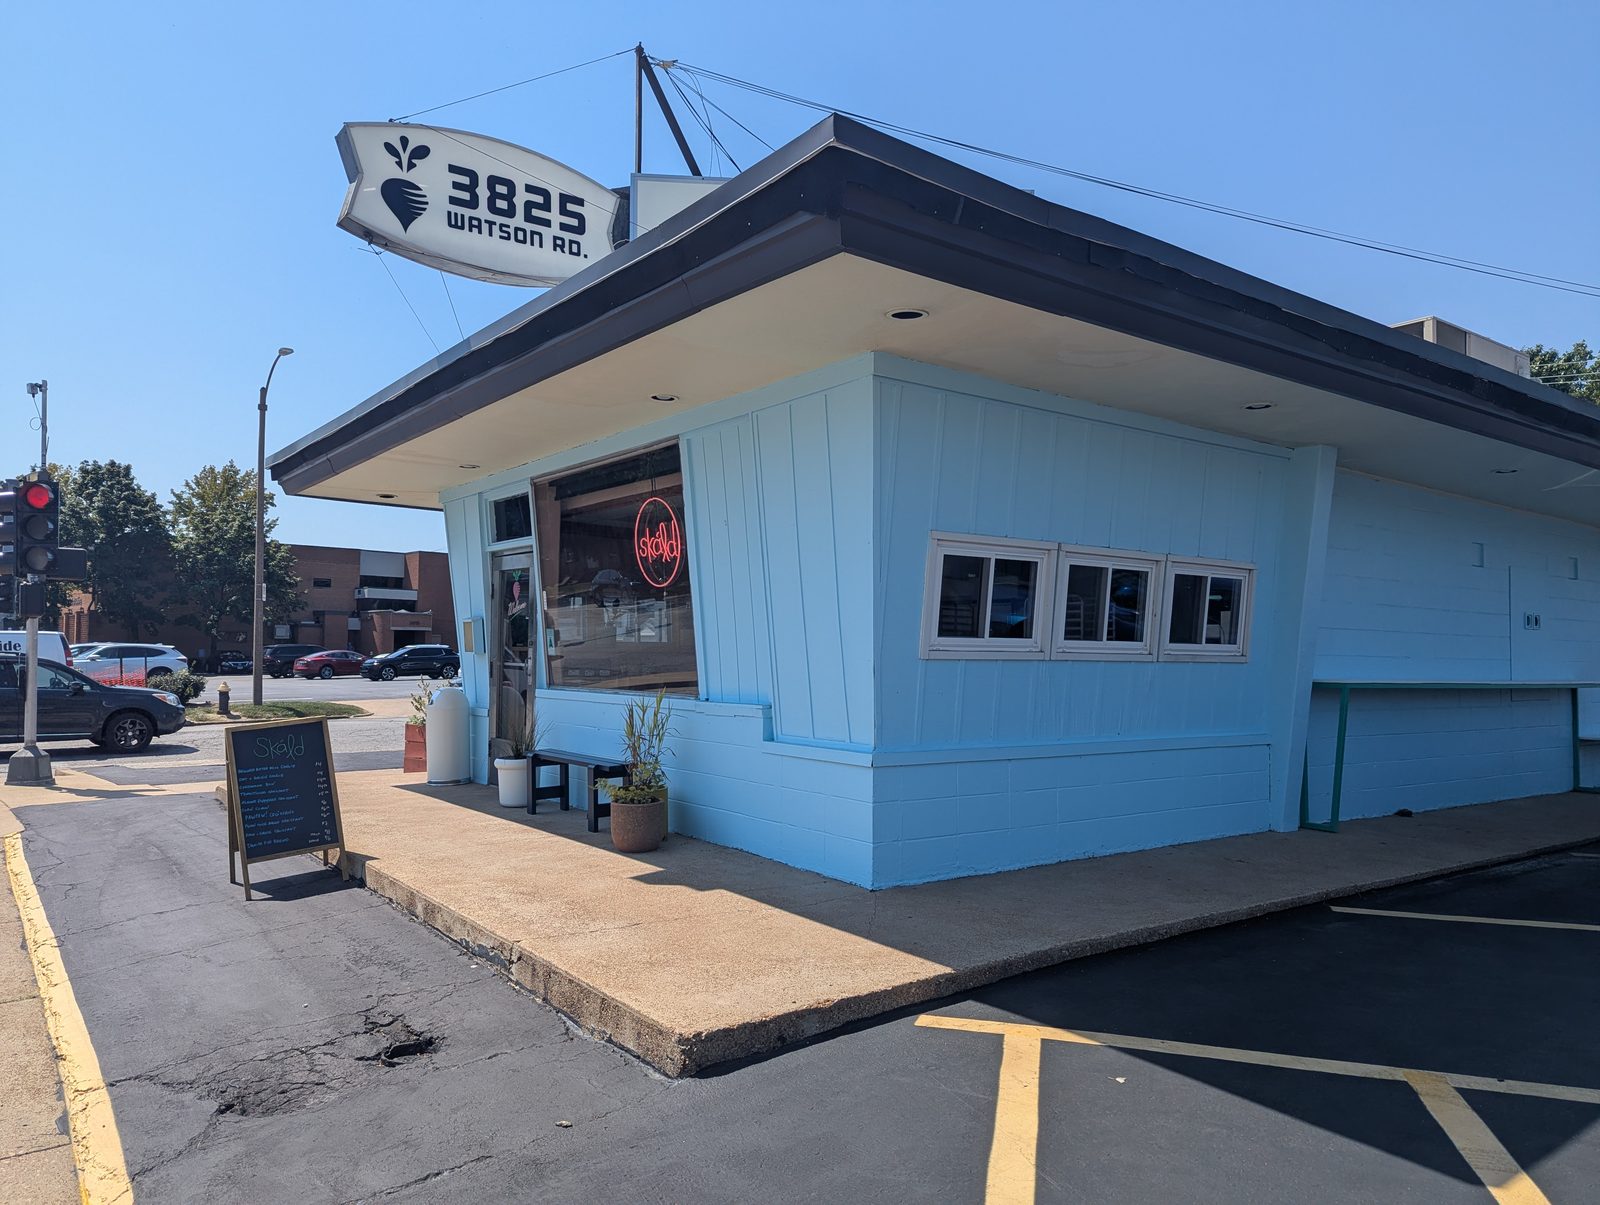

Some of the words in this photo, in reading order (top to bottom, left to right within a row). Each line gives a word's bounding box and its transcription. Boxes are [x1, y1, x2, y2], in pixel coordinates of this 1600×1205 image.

[448, 163, 586, 236] 3825
[447, 210, 543, 248] WATSON
[552, 235, 588, 259] RD.
[639, 519, 680, 563] skáld
[253, 734, 304, 760] Skáld
